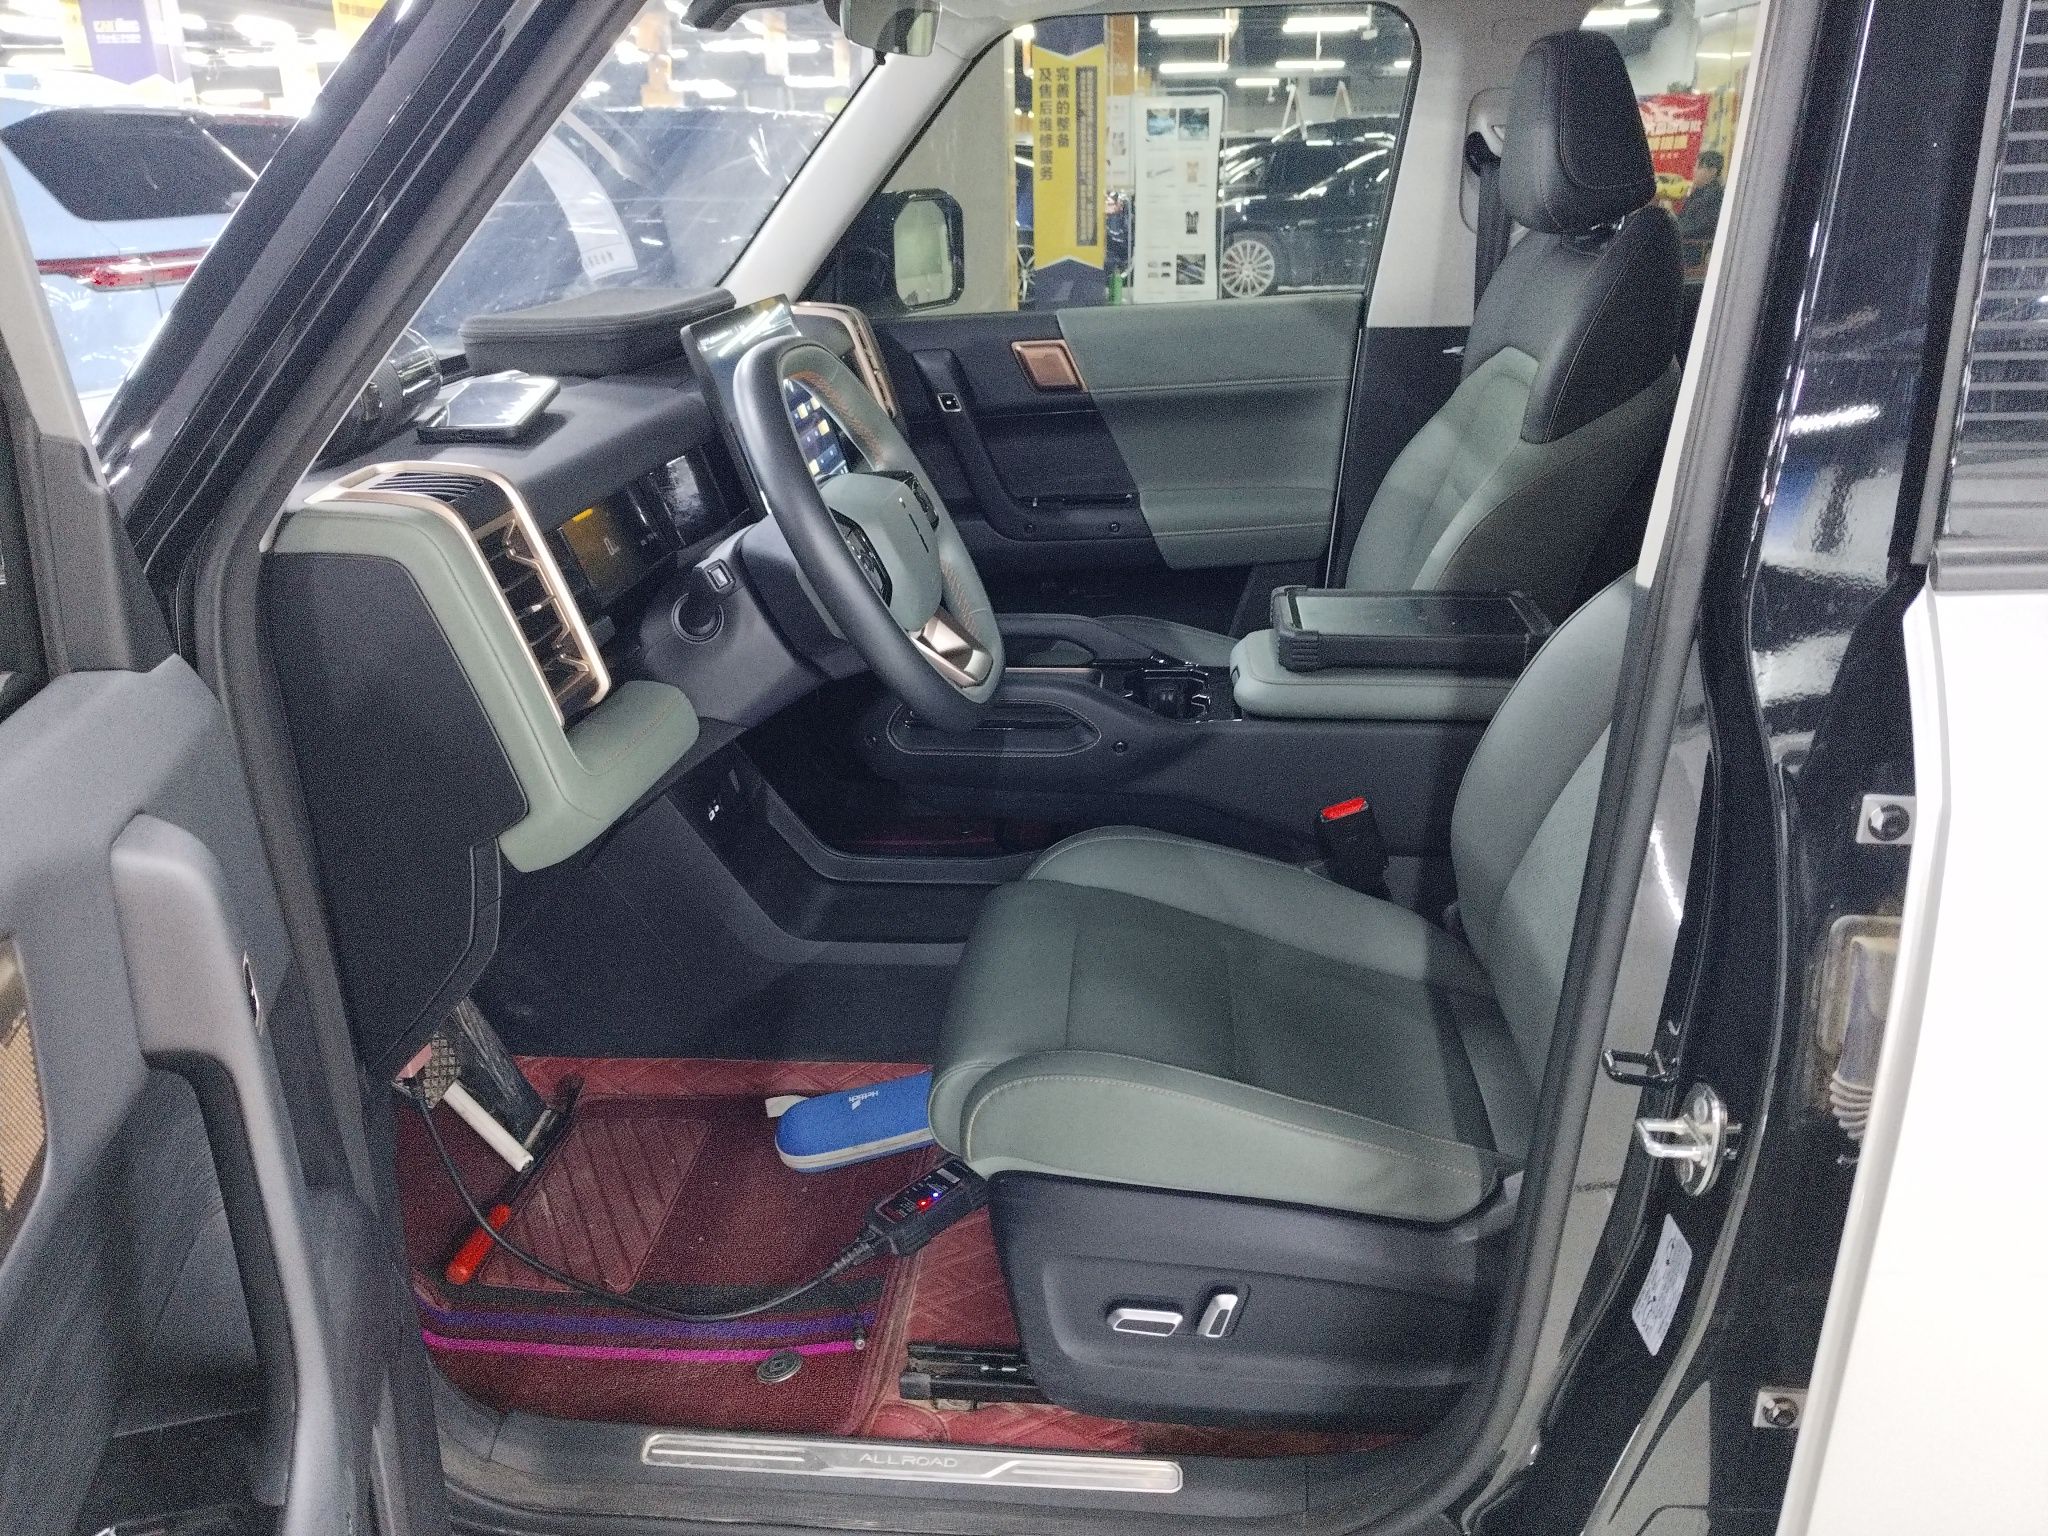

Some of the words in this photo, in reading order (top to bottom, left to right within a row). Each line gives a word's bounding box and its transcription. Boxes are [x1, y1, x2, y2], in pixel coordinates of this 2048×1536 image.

[1039, 67, 1053, 181] 及售后维修服务
